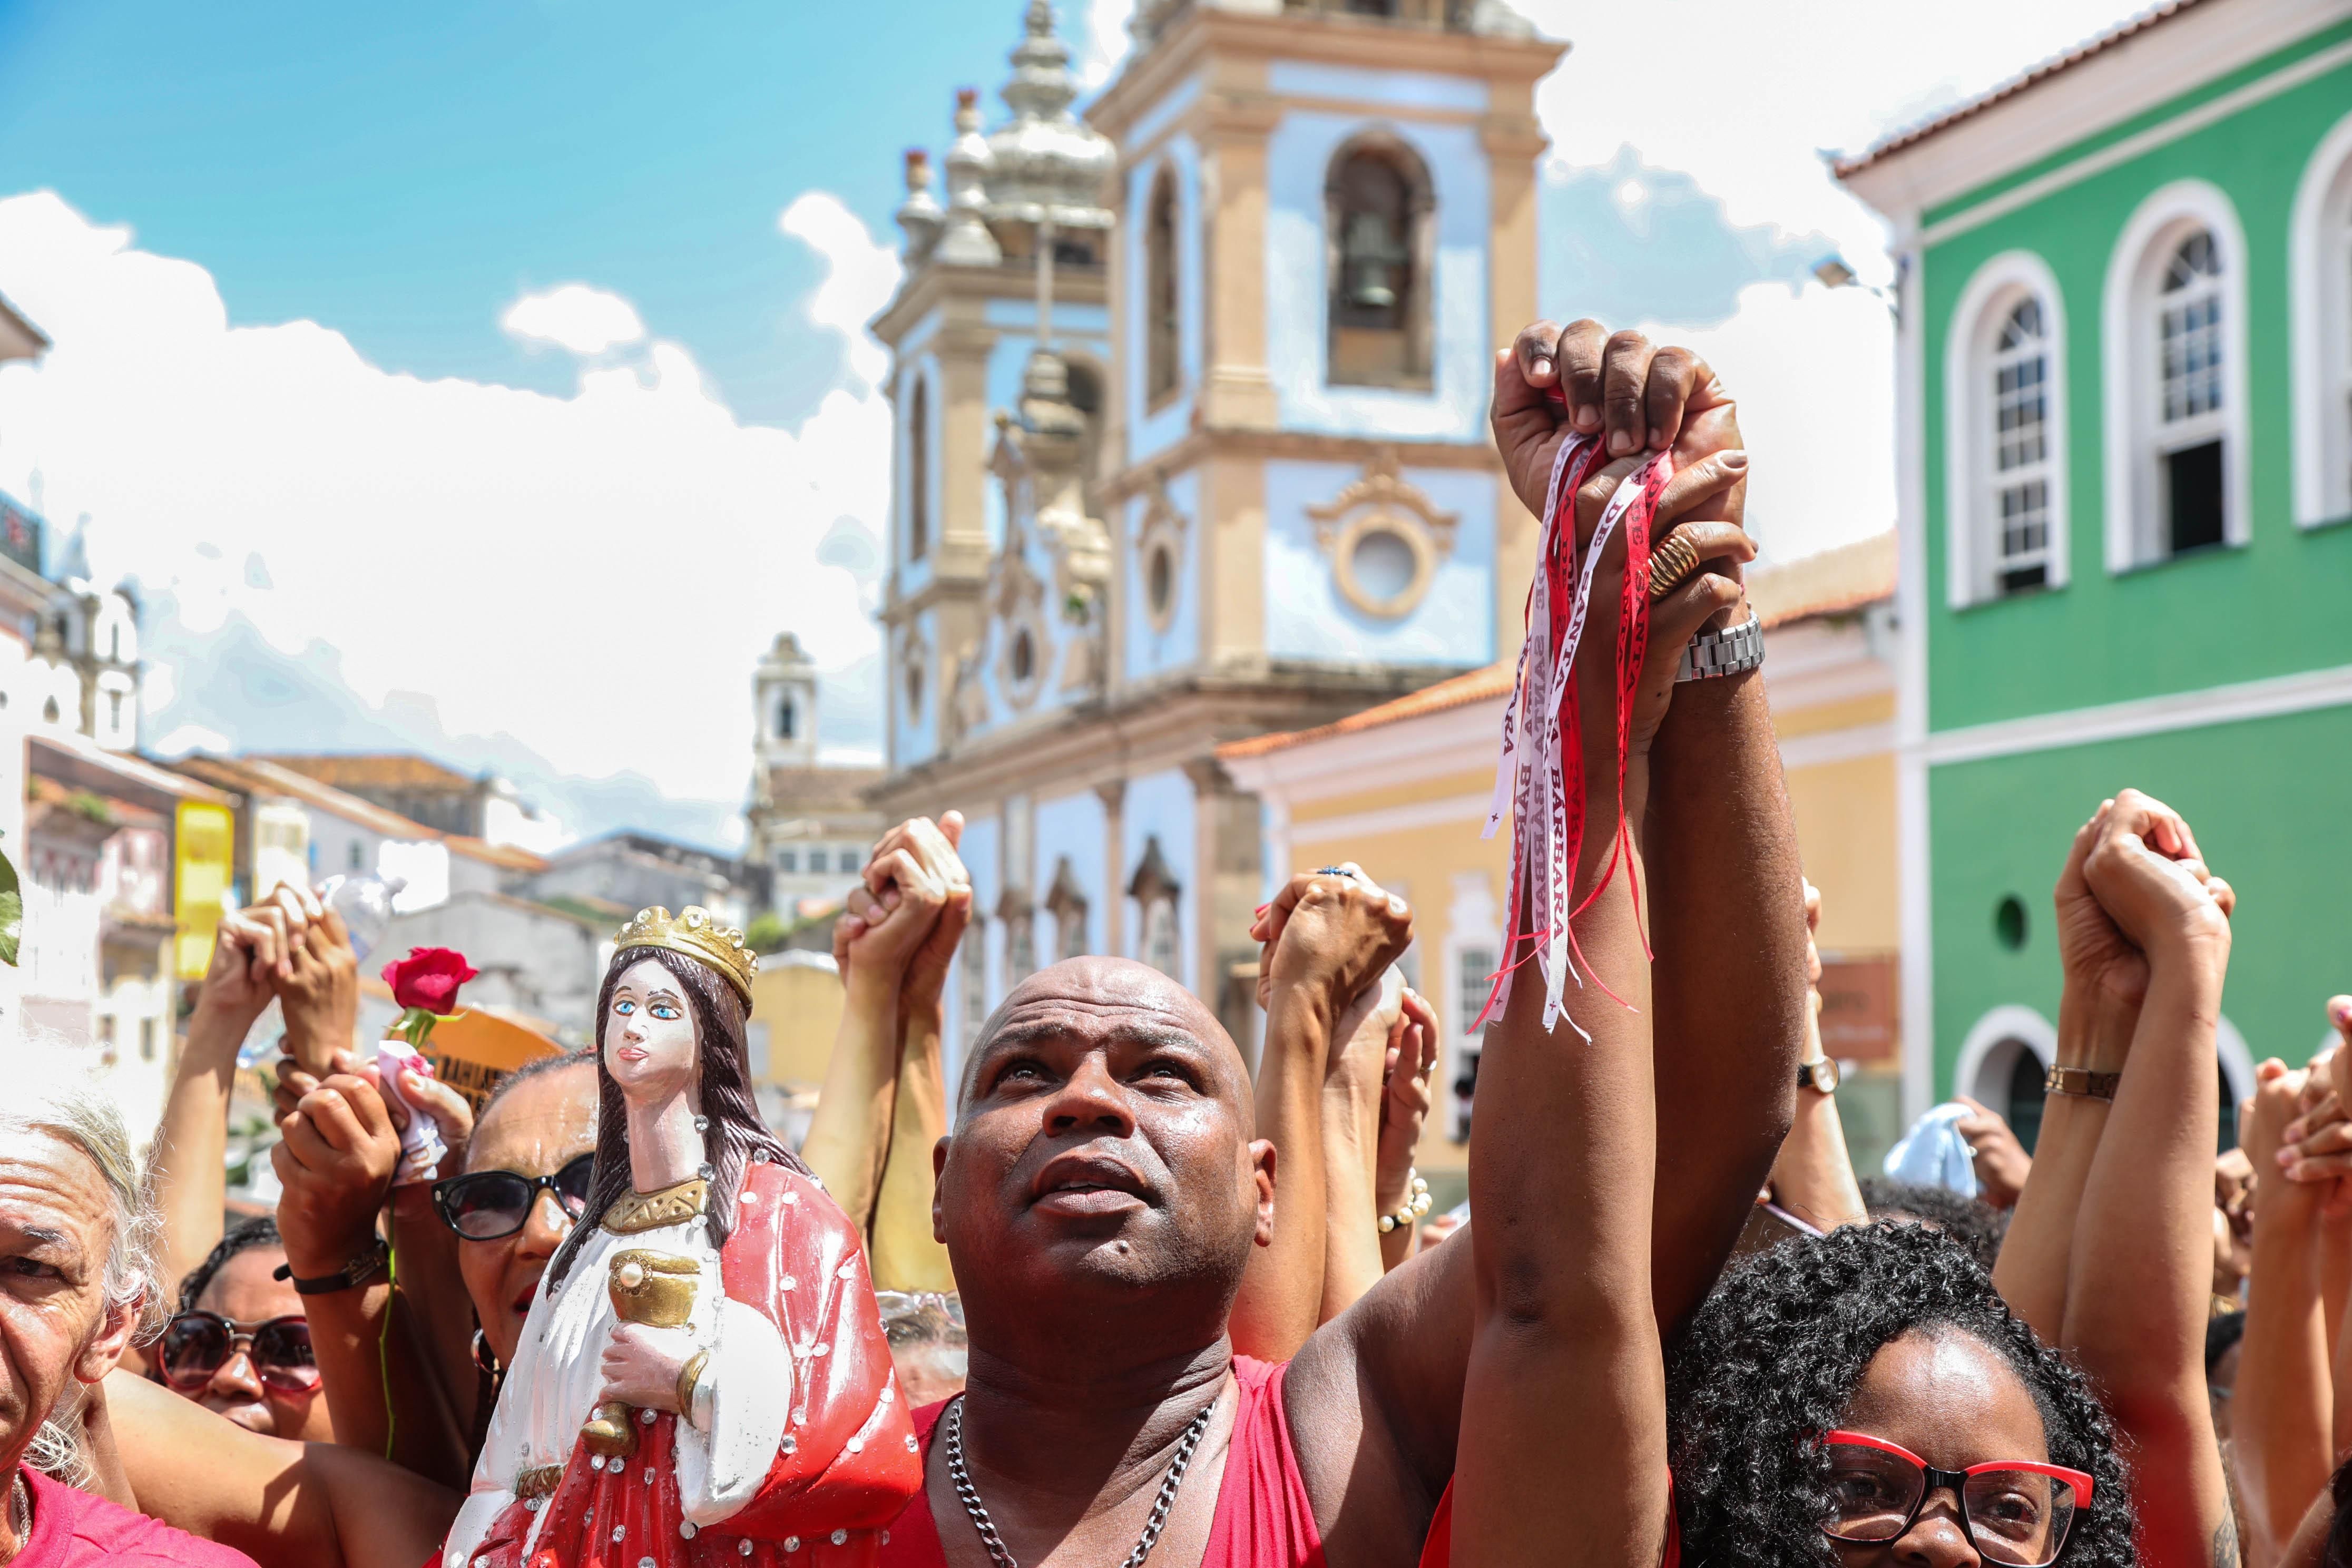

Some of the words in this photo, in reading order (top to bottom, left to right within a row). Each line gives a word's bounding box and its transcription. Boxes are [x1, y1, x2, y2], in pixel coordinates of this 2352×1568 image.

[1594, 501, 1624, 547] DE
[1631, 504, 1643, 546] DE
[1555, 571, 1590, 692] SANTA
[1626, 570, 1645, 693] SANTA
[1551, 766, 1566, 940] BÁRBARA
